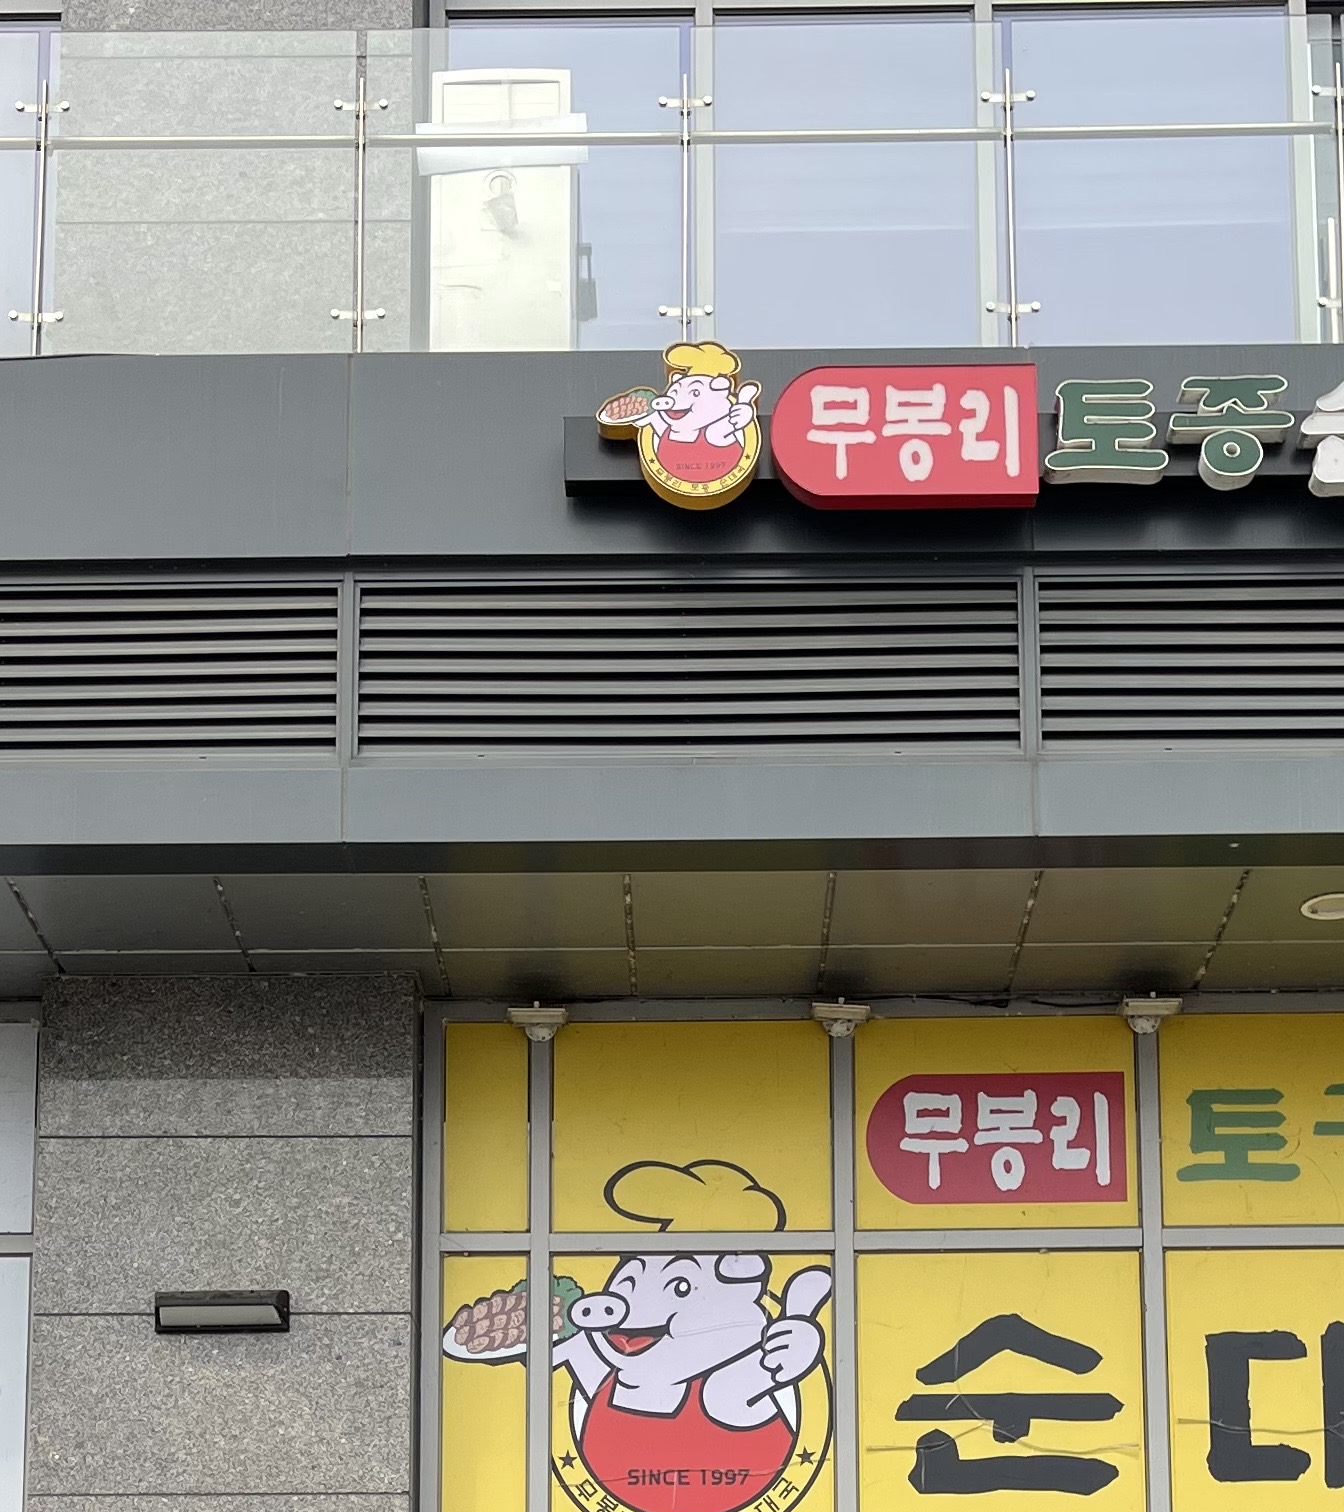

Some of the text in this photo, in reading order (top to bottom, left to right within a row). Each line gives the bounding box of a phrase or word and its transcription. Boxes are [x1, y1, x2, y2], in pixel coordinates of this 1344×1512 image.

[807, 383, 1020, 482] 무봉리
[1045, 374, 1295, 491] 토종
[893, 1089, 1110, 1191] 무봉리
[627, 1468, 751, 1486] SINCE 1997
